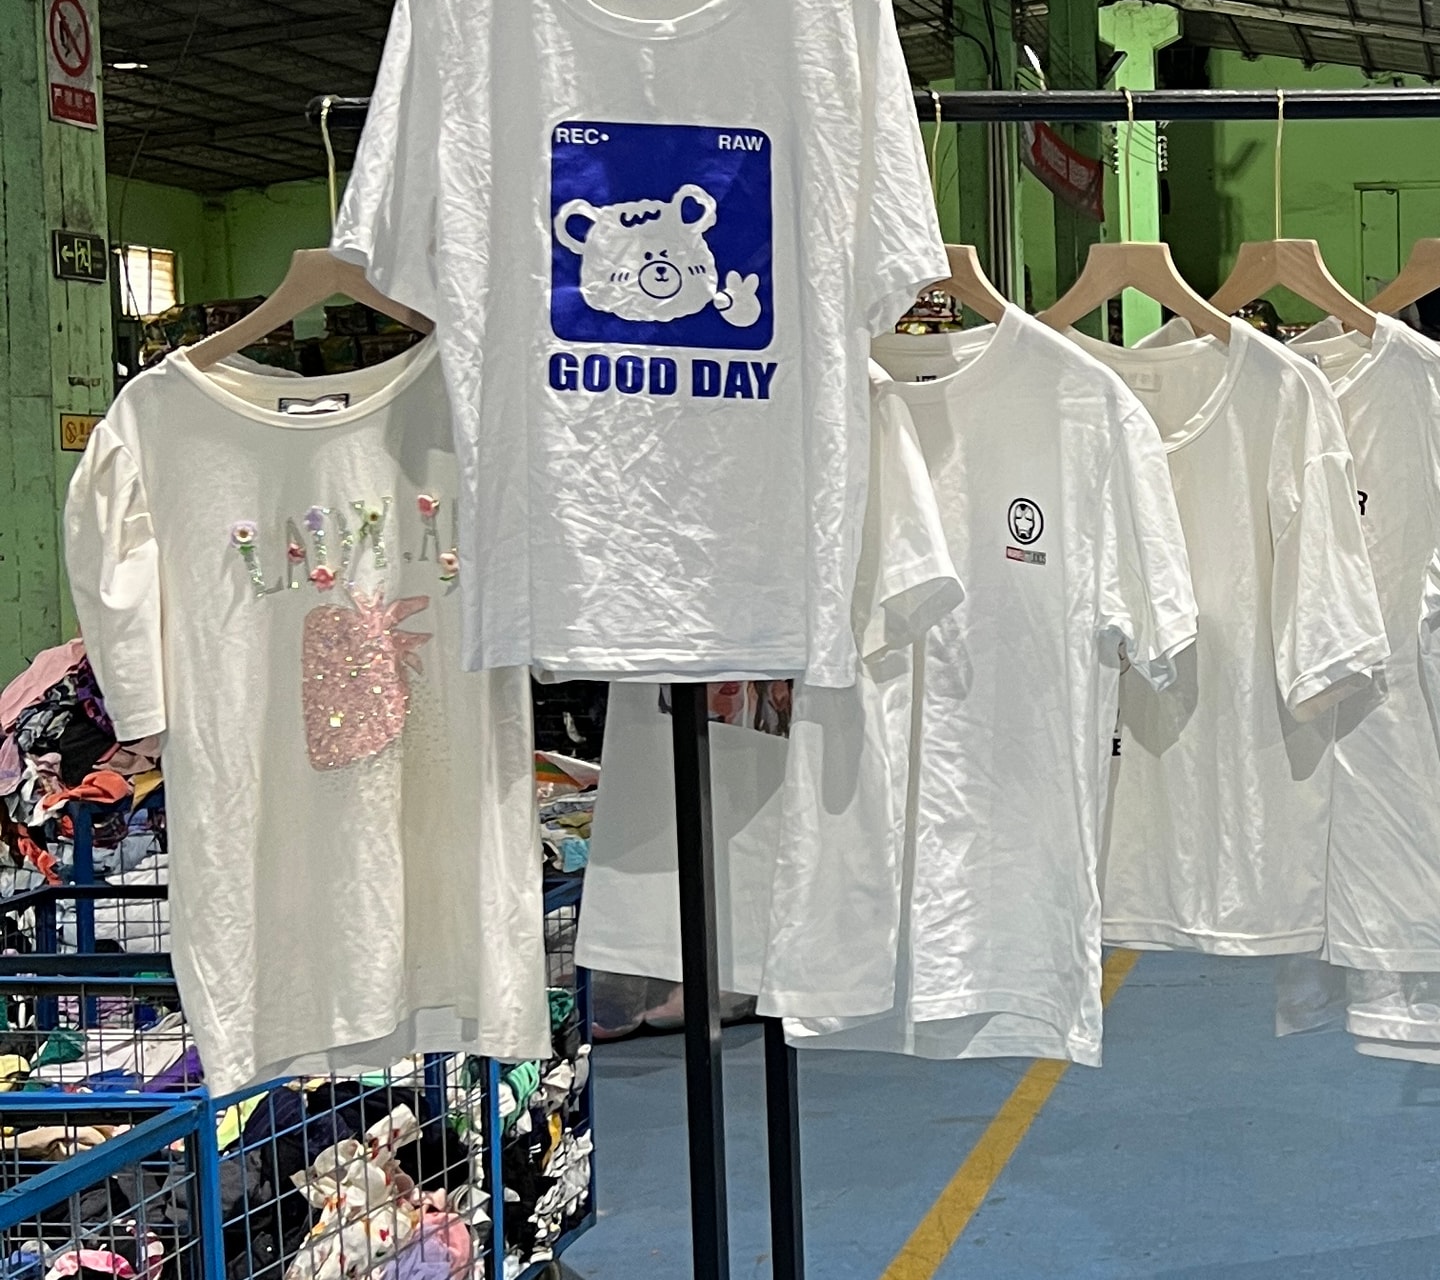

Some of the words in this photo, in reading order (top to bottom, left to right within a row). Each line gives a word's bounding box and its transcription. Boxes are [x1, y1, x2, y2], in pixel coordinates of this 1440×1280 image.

[717, 134, 764, 152] RAW
[548, 354, 678, 395] GOOD
[691, 358, 779, 400] DAY
